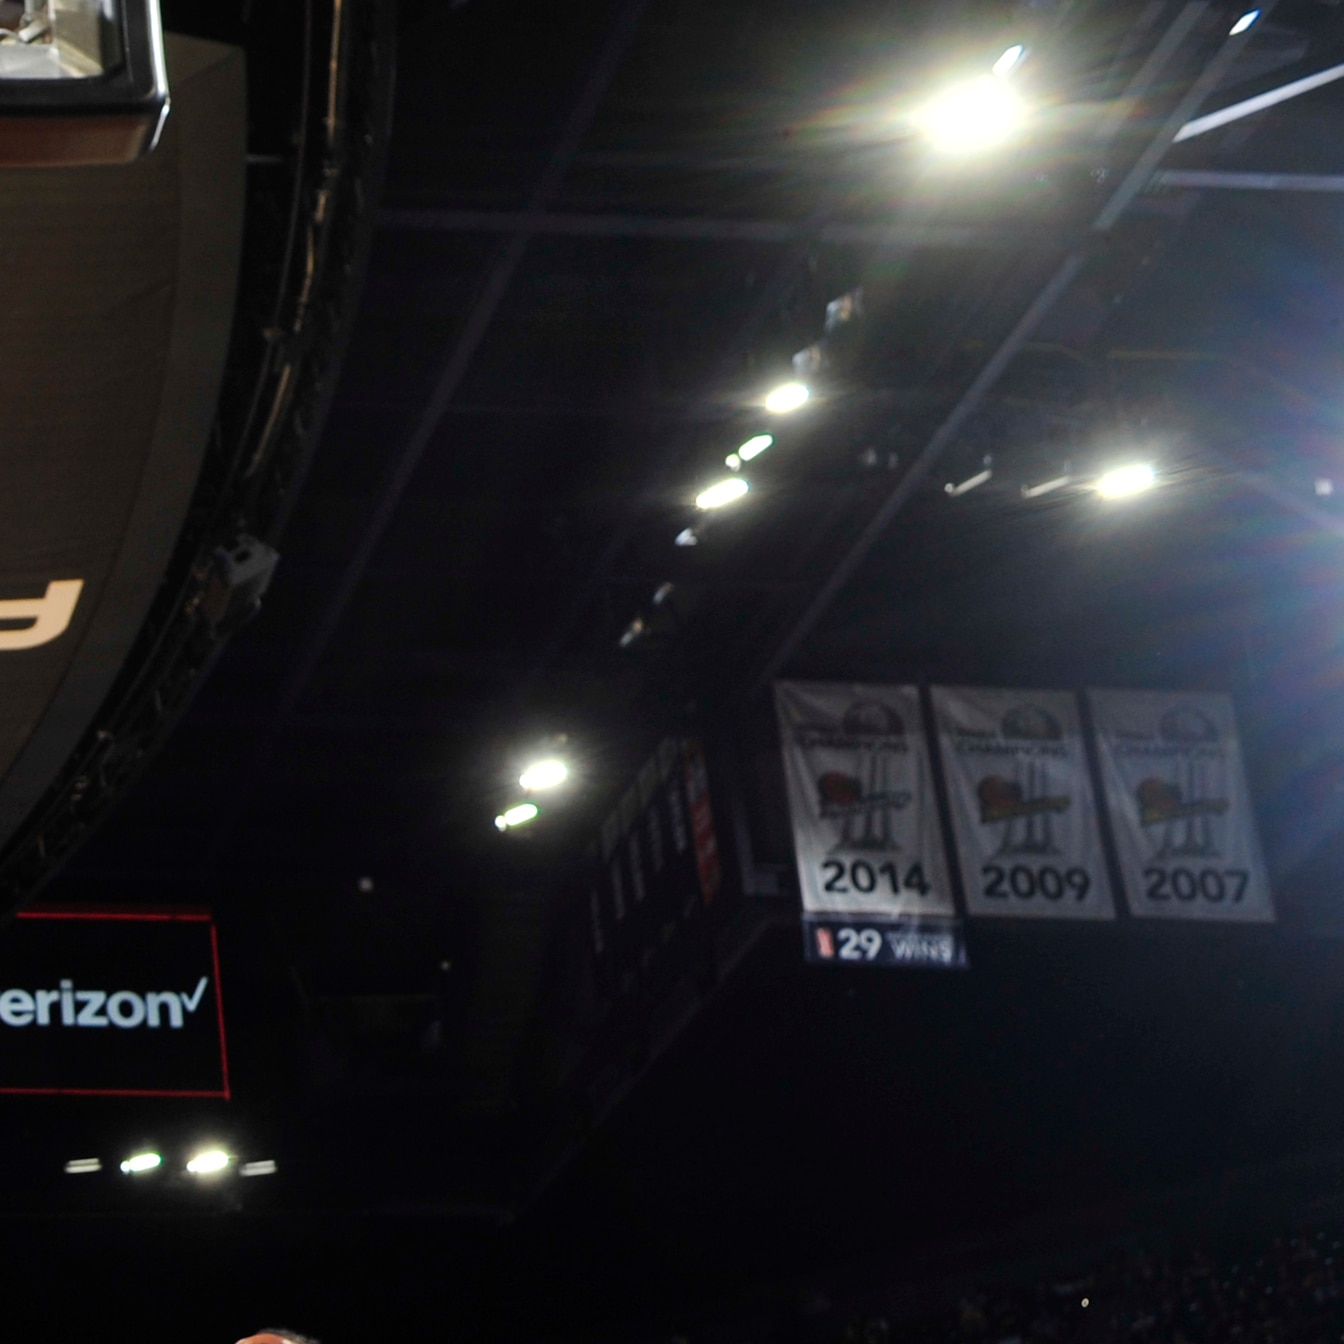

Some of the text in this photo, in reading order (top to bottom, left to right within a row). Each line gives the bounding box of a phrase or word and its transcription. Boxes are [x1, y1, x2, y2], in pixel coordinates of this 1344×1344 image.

[822, 858, 932, 898] 2014
[980, 863, 1090, 902] 2009
[1143, 864, 1250, 904] 2007
[837, 927, 882, 961] 29
